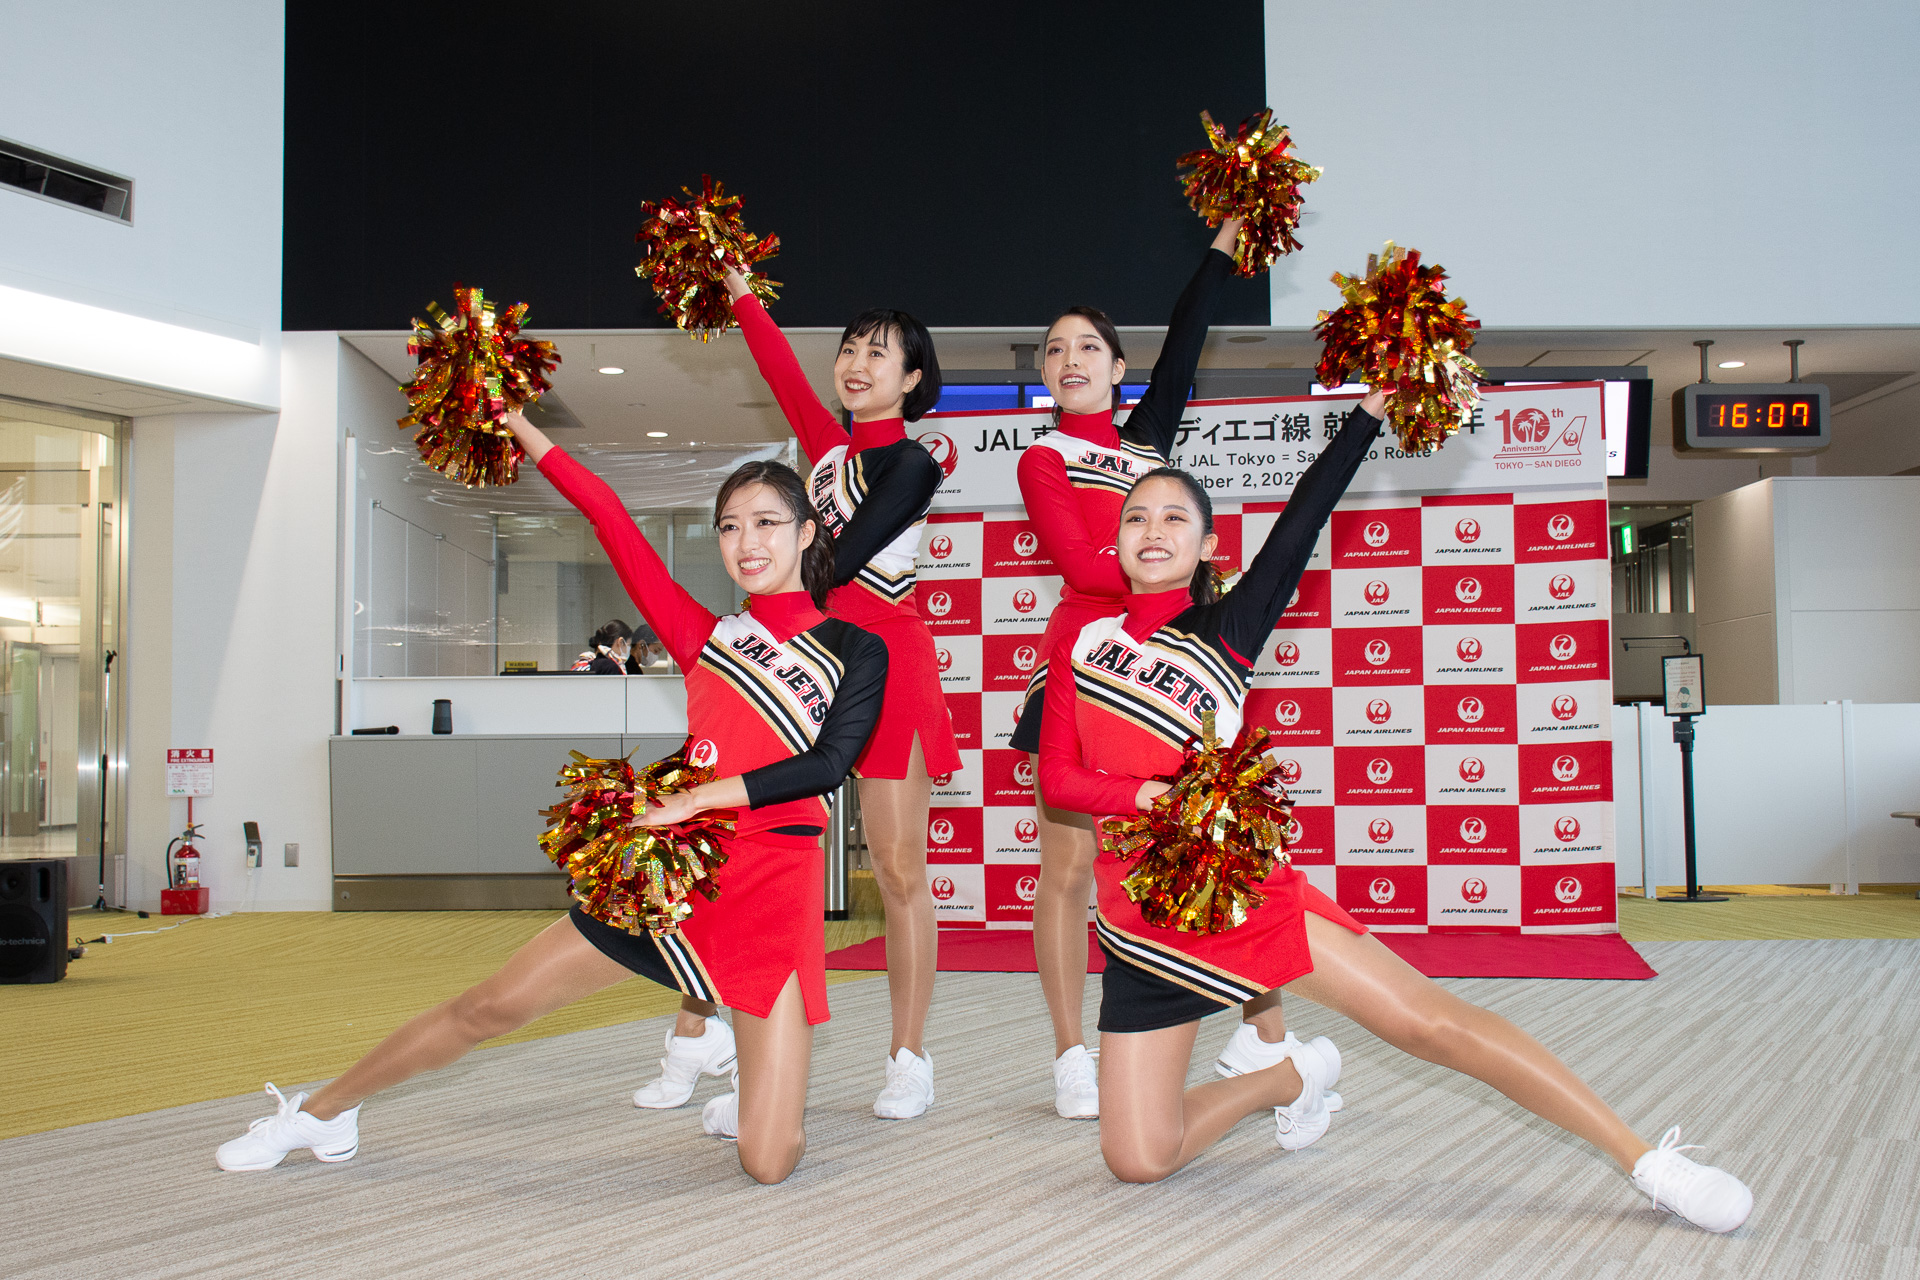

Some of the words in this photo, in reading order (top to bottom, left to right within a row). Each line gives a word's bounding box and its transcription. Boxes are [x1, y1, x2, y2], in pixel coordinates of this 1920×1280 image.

[1719, 403, 1809, 428] 16:07
[1079, 450, 1138, 480] JAL
[1190, 454, 1220, 467] JAL
[1226, 453, 1276, 466] Tokyo
[1555, 459, 1582, 467] DIEGO
[730, 633, 783, 671] JAL
[774, 663, 830, 726] JETS
[1084, 639, 1143, 680] JAL
[1135, 658, 1219, 724] JETS
